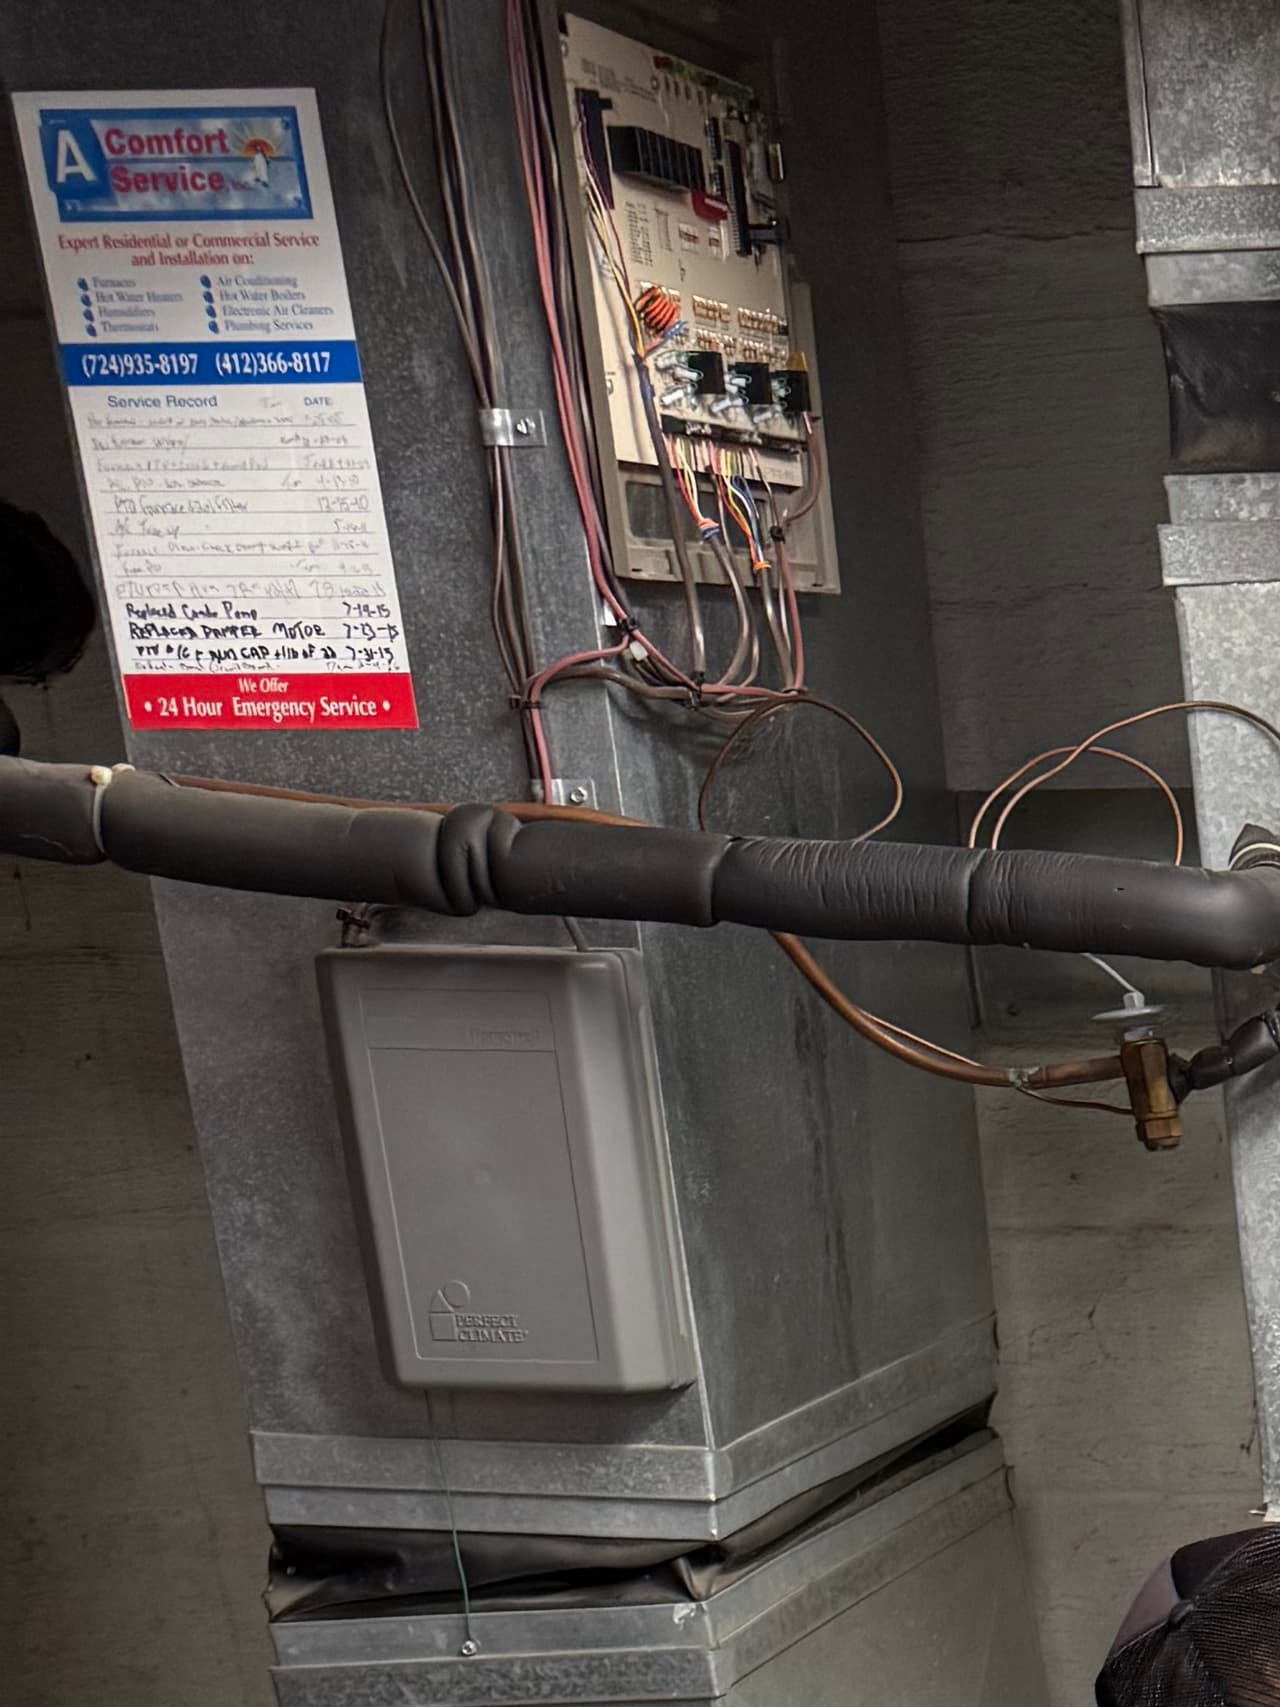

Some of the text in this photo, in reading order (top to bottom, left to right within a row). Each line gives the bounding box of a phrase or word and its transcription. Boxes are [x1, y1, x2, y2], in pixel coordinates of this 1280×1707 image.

[104, 128, 230, 155] Comfort
[56, 130, 97, 183] A
[58, 232, 320, 254] Expert Residential or Commercial Service
[132, 252, 254, 267] and Installation on:
[81, 351, 331, 378] (724)935-8197 (412)366-8117
[107, 395, 218, 409] Service Record
[303, 397, 331, 407] DATE
[239, 678, 289, 693] We Offer
[158, 695, 377, 723] 24 Hour Emergency Service
[455, 1312, 520, 1328] PERFECT
[457, 1328, 527, 1344] CLIMATE
